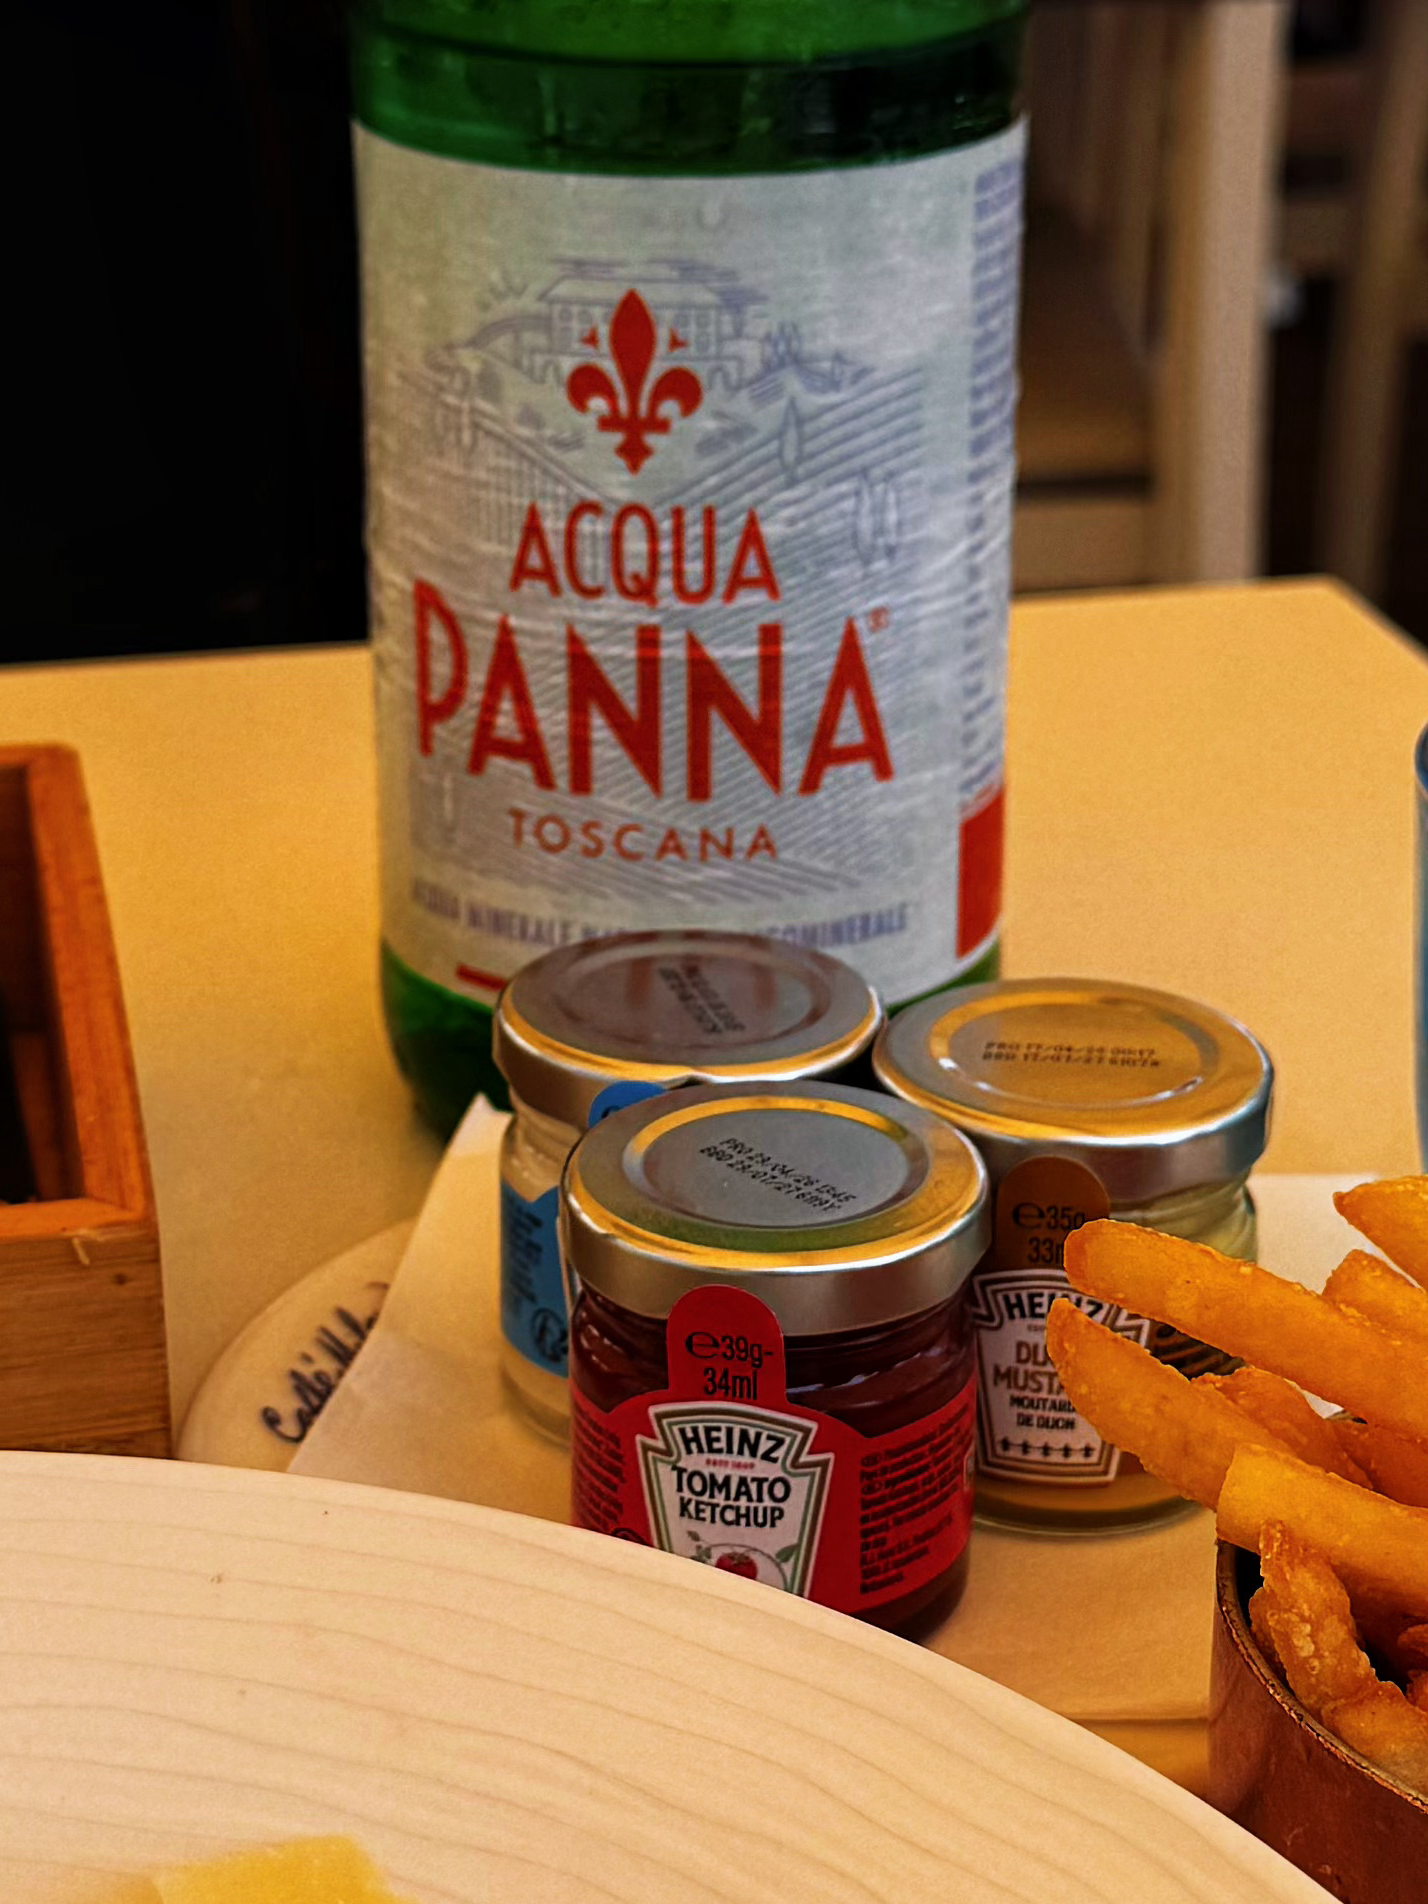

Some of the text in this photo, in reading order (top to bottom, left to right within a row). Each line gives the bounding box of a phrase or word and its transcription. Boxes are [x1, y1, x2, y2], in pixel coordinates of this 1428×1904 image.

[508, 499, 780, 609] ACQUA
[412, 578, 895, 802] PANNA
[508, 806, 779, 862] TOSCANA
[1027, 1236, 1064, 1265] 33m
[702, 1366, 759, 1401] 34ml
[993, 1362, 1065, 1396] MUST
[677, 1424, 786, 1464] HEINZ
[671, 1462, 792, 1504] TOMATO
[678, 1496, 785, 1529] KETCHUP
